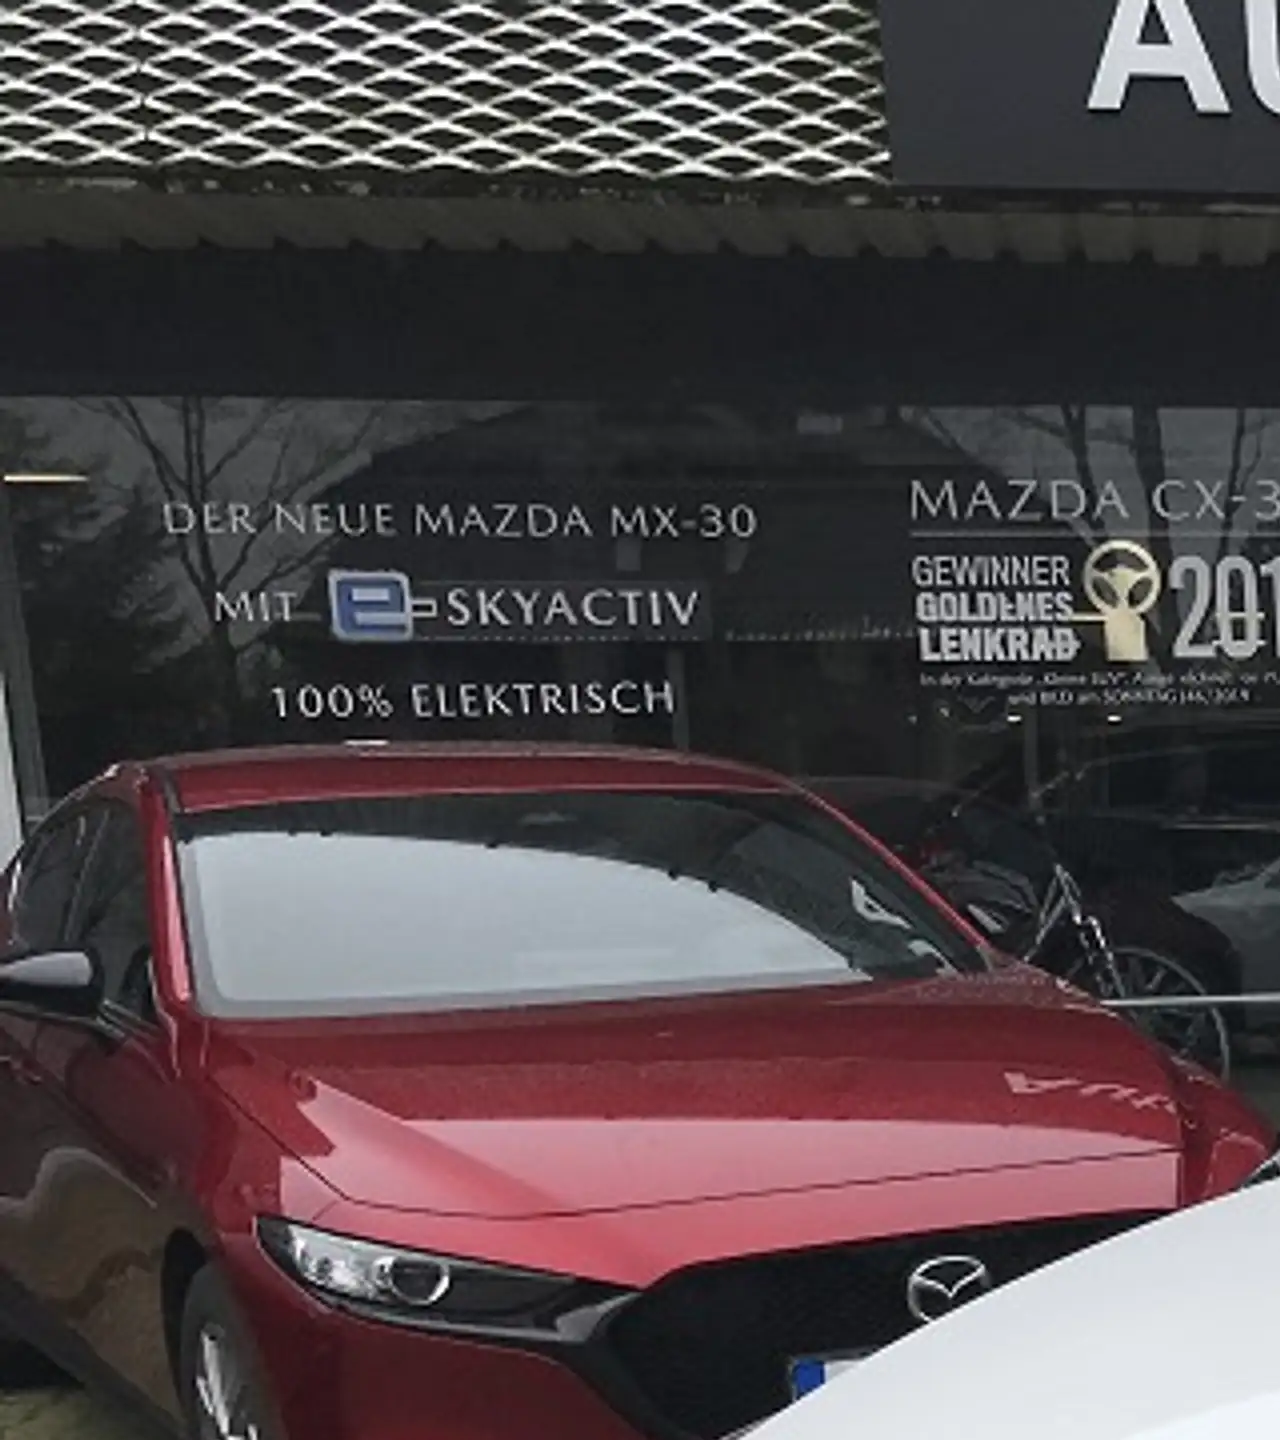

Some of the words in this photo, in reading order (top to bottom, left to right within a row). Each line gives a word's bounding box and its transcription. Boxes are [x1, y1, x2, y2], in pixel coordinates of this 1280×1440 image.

[910, 479, 1131, 521] MAZDA
[162, 503, 257, 535] DER
[276, 503, 397, 536] NEUE
[414, 505, 594, 537] MAZDA
[611, 506, 757, 538] MX-30
[911, 555, 1071, 587] GEWINNER
[213, 592, 298, 623] MIT
[915, 592, 1074, 623] GOLDENES
[918, 627, 1080, 663] LENKRAD
[271, 684, 394, 720] 100%
[411, 681, 675, 718] ELEKTRISCH
